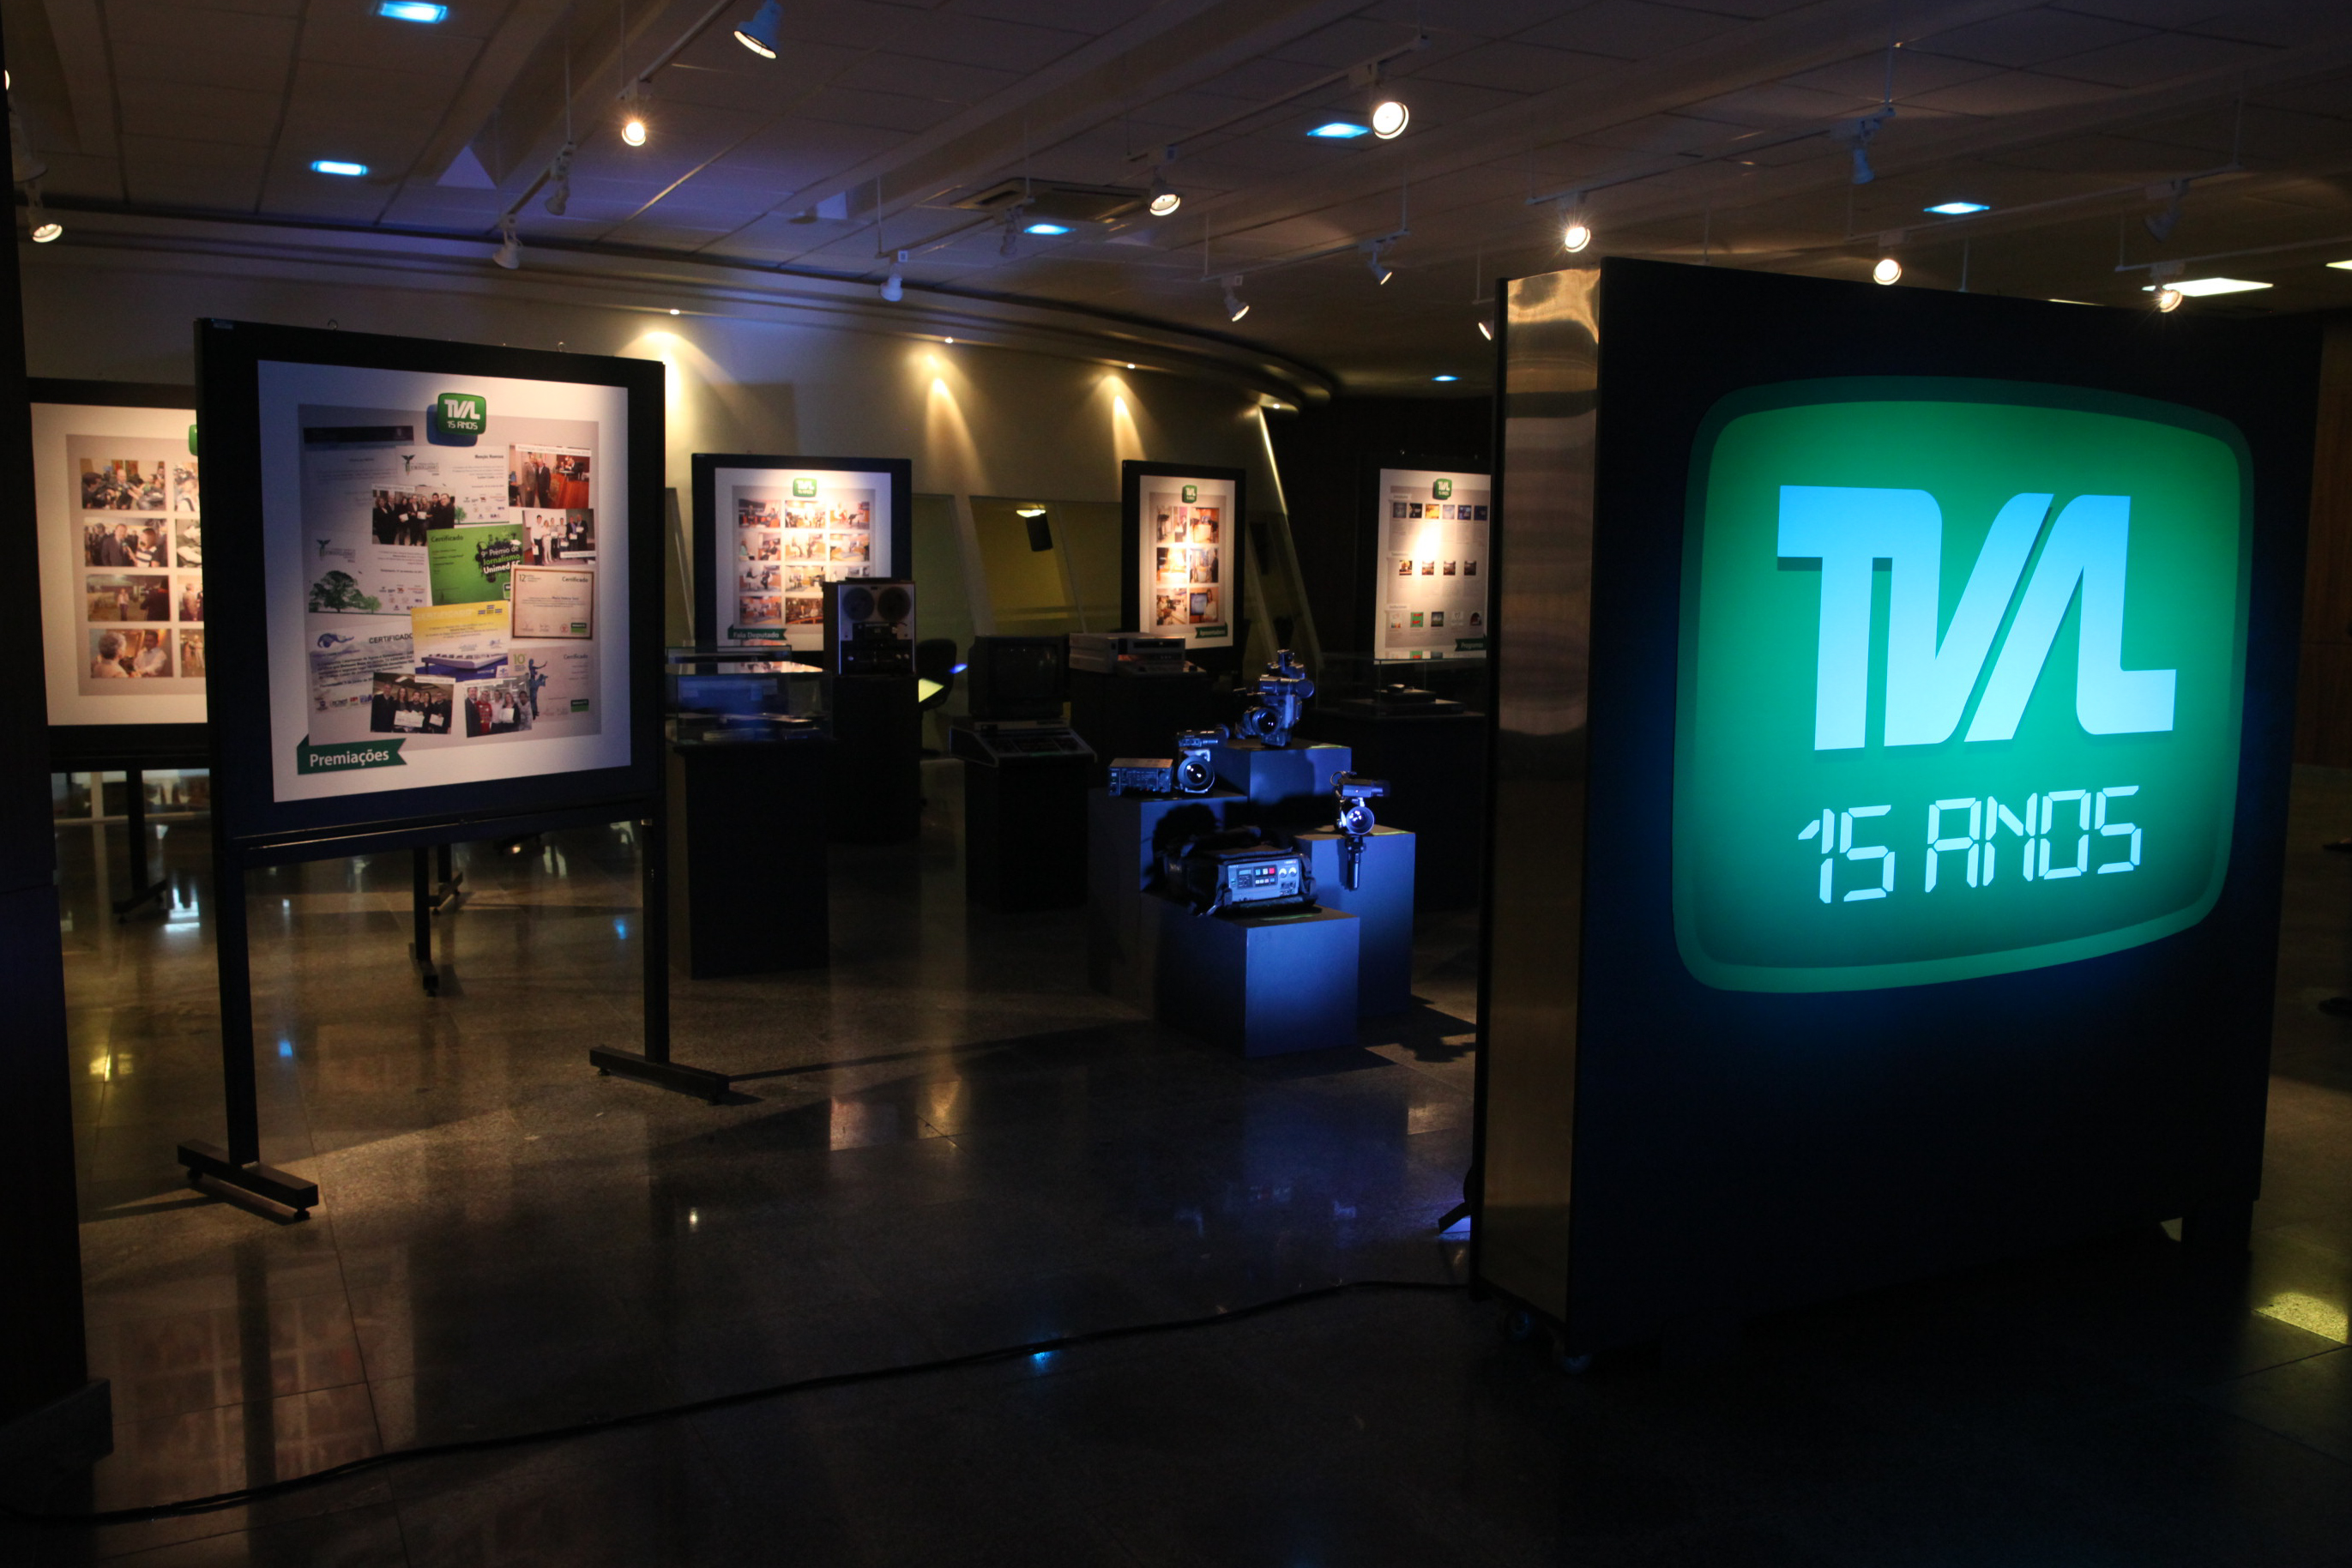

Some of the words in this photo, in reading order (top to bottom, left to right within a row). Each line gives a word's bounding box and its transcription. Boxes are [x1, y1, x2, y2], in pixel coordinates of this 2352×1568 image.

[457, 421, 478, 430] ANOS
[431, 534, 464, 543] Certificado
[489, 548, 510, 557] Prêmio
[483, 554, 521, 565] Jornalismo
[483, 562, 510, 574] Unimed
[310, 749, 389, 768] Premiações
[1798, 805, 1895, 903] 15
[1925, 785, 2142, 893] ANOS
